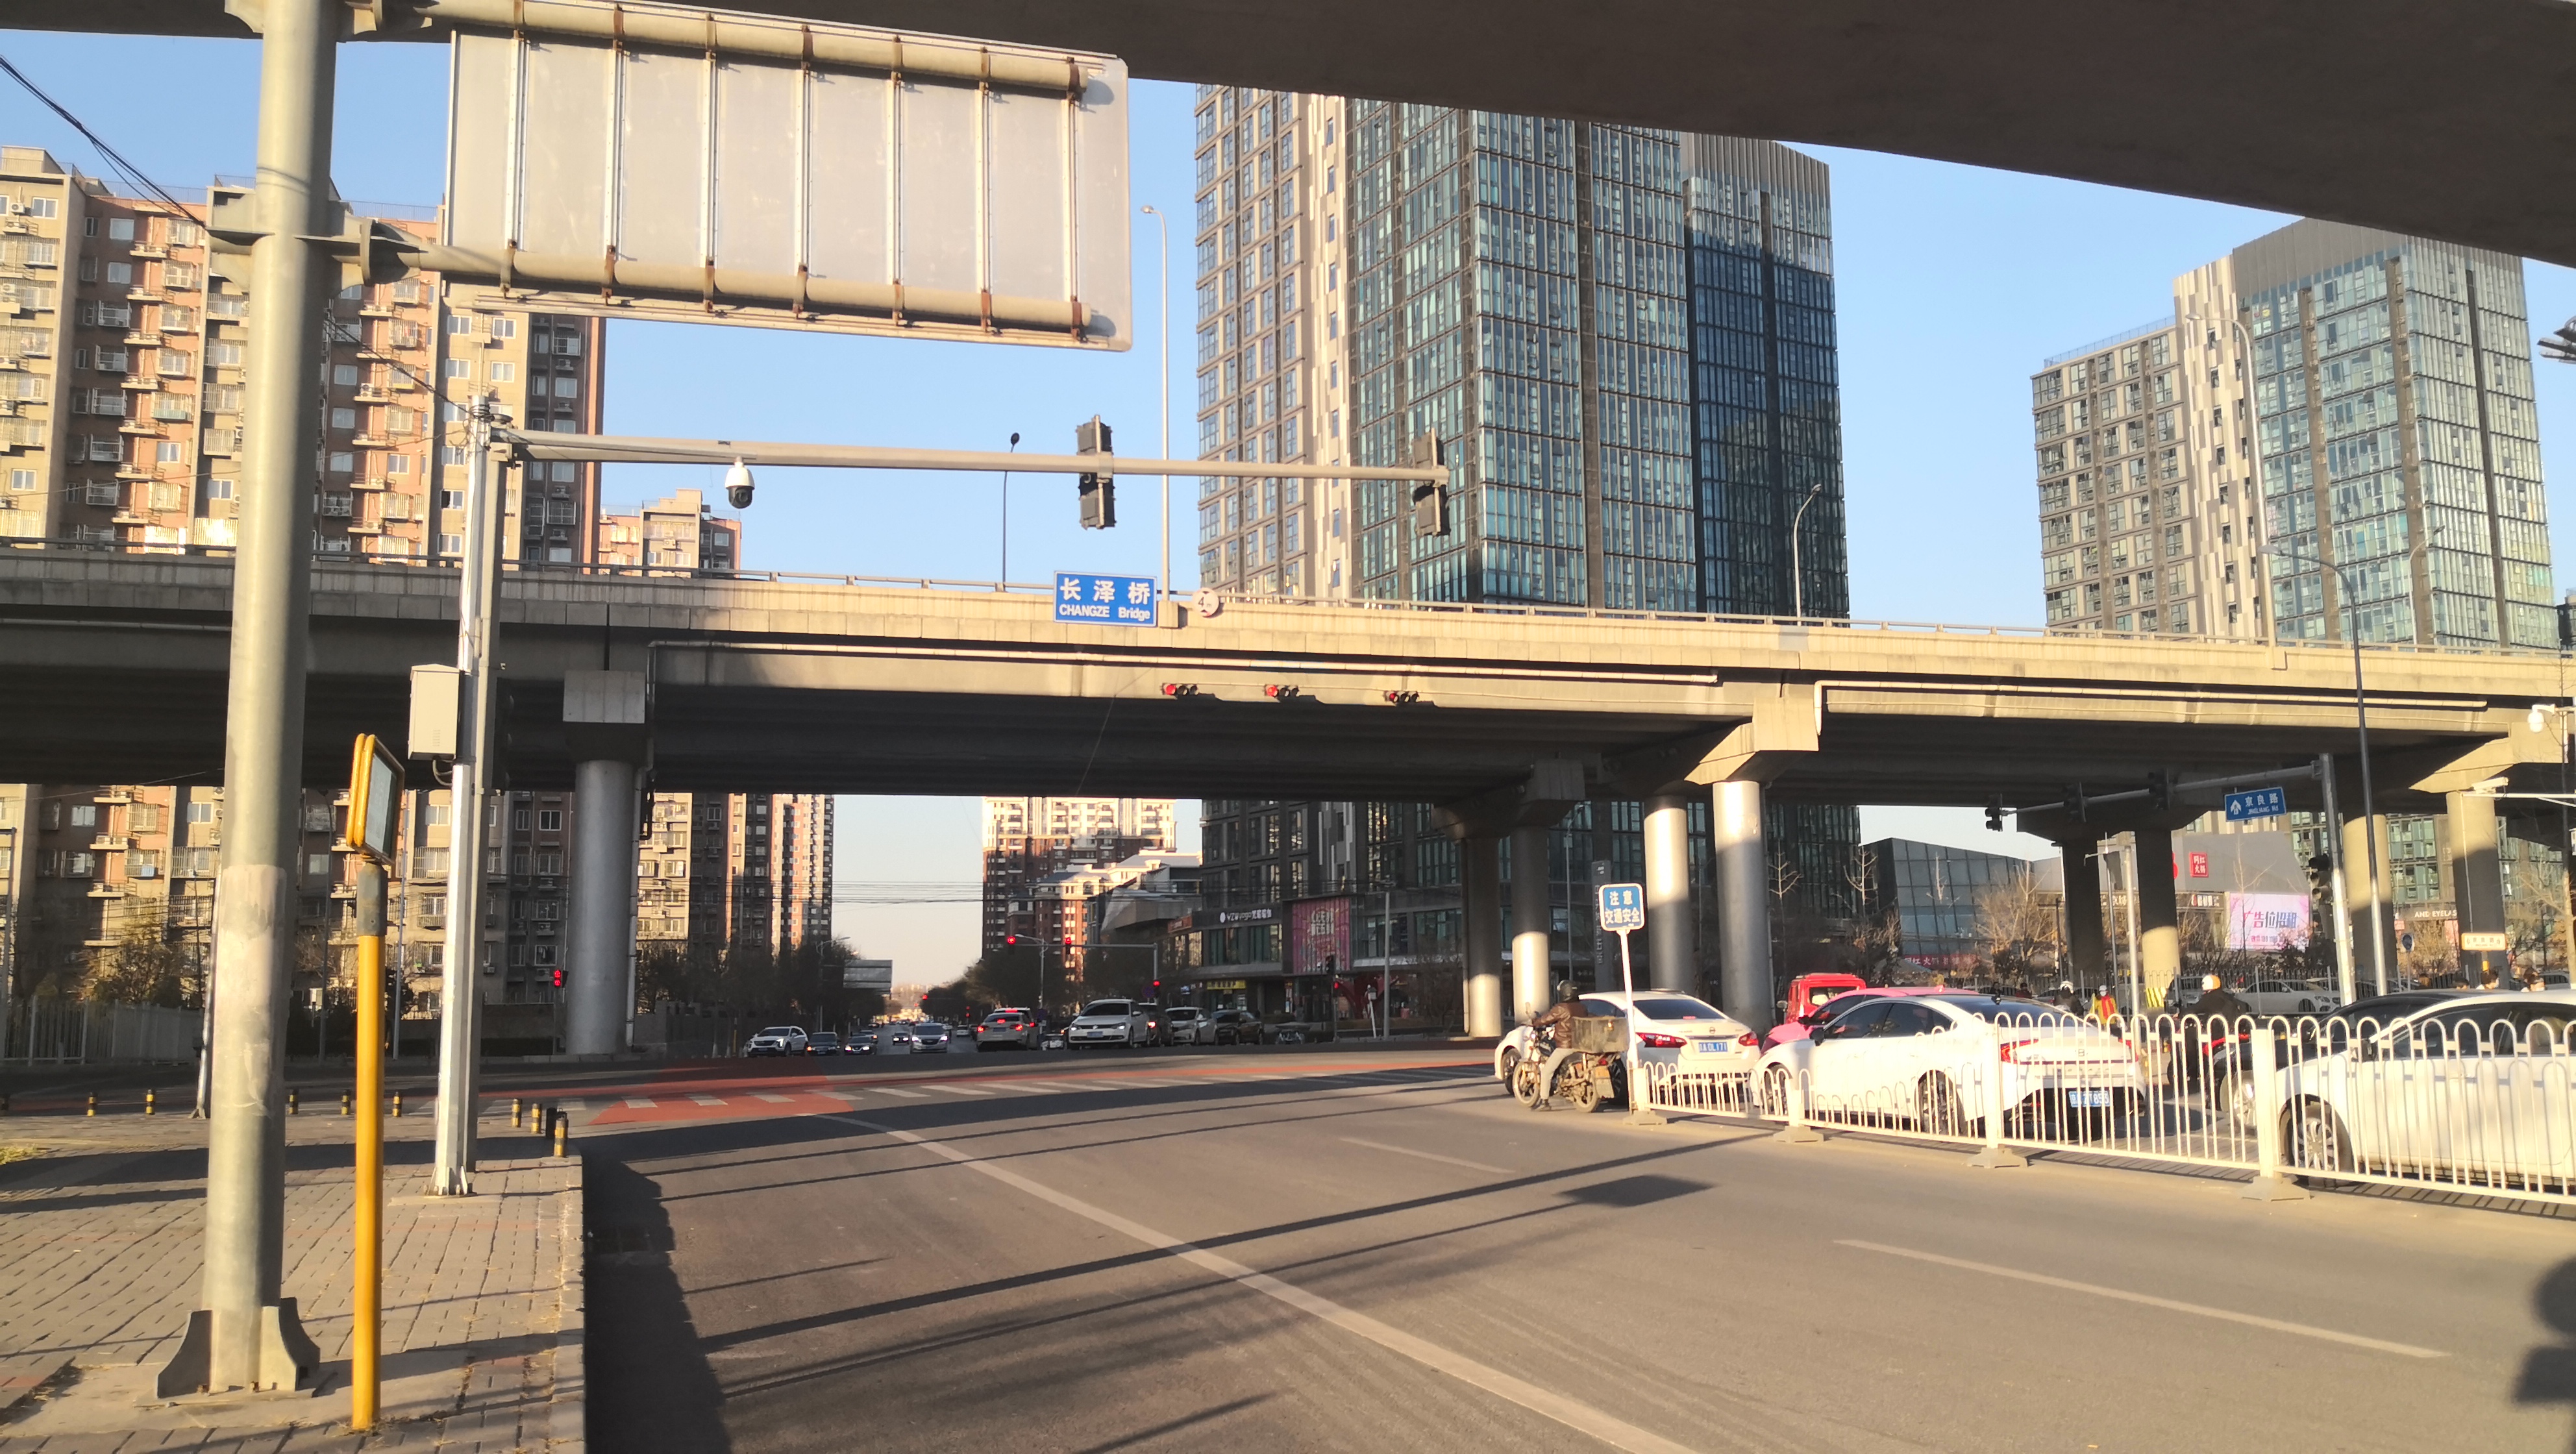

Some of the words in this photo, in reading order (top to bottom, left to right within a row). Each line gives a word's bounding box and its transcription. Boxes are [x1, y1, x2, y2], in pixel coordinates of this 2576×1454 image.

[1059, 577, 1151, 605] 长泽桥
[1059, 604, 1110, 618] CHANGZE
[1118, 606, 1151, 622] Bridge
[1609, 890, 1633, 906] 注意
[1604, 906, 1641, 924] 交通安全
[2243, 911, 2297, 929] 广告位招租
